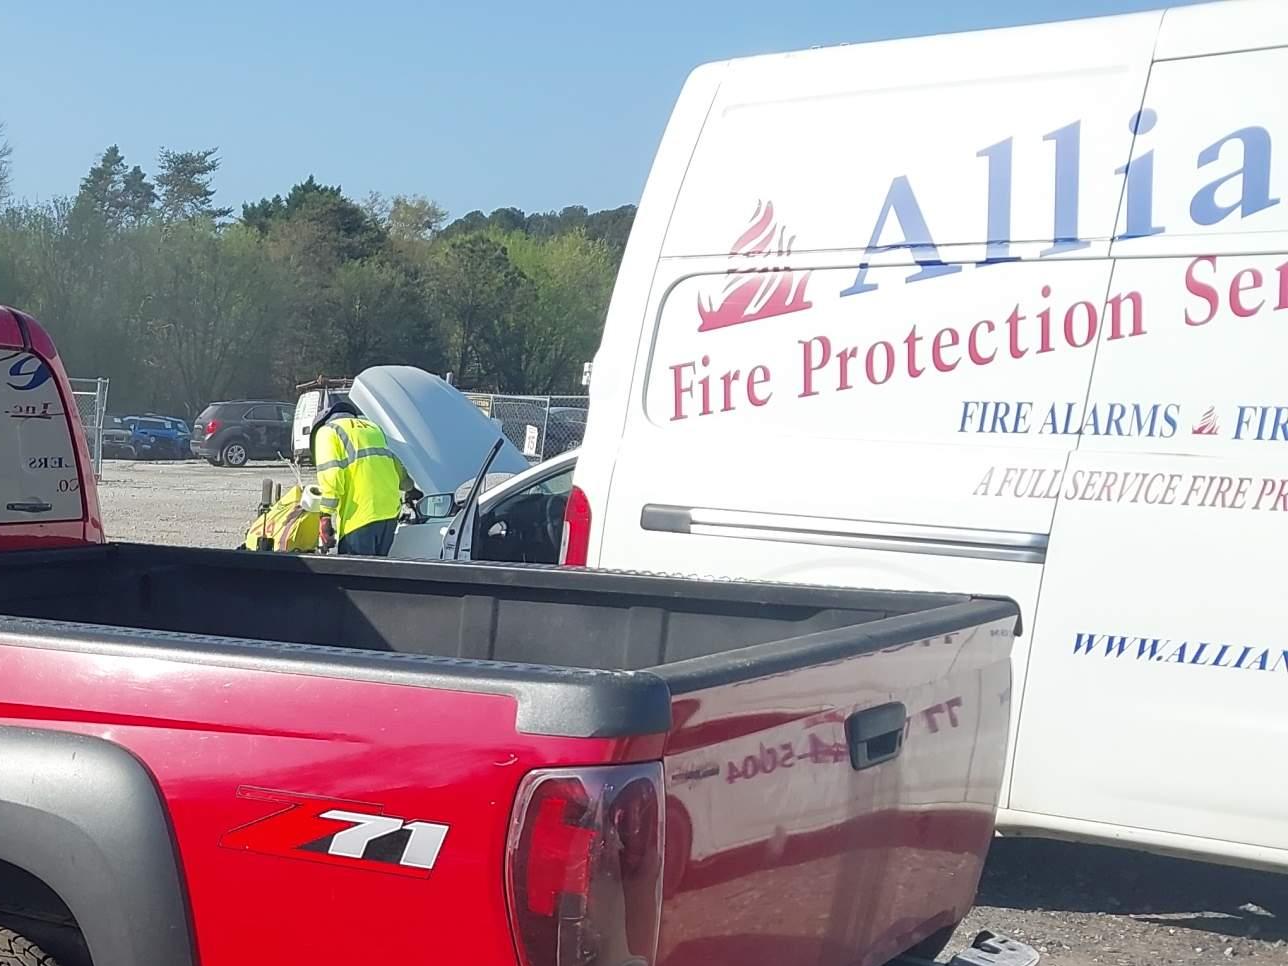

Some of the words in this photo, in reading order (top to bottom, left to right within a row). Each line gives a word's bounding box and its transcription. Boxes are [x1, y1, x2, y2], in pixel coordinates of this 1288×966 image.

[839, 108, 1281, 298] Allia
[669, 354, 772, 422] Fire
[797, 285, 1147, 398] Protection
[958, 400, 1033, 435] FIRE
[1038, 401, 1181, 438] ALARMS
[973, 466, 995, 496] A
[995, 467, 1062, 499] FULL
[1064, 469, 1183, 505] SERVICE
[1181, 475, 1253, 510] FIRE
[218, 785, 450, 871] Z71
